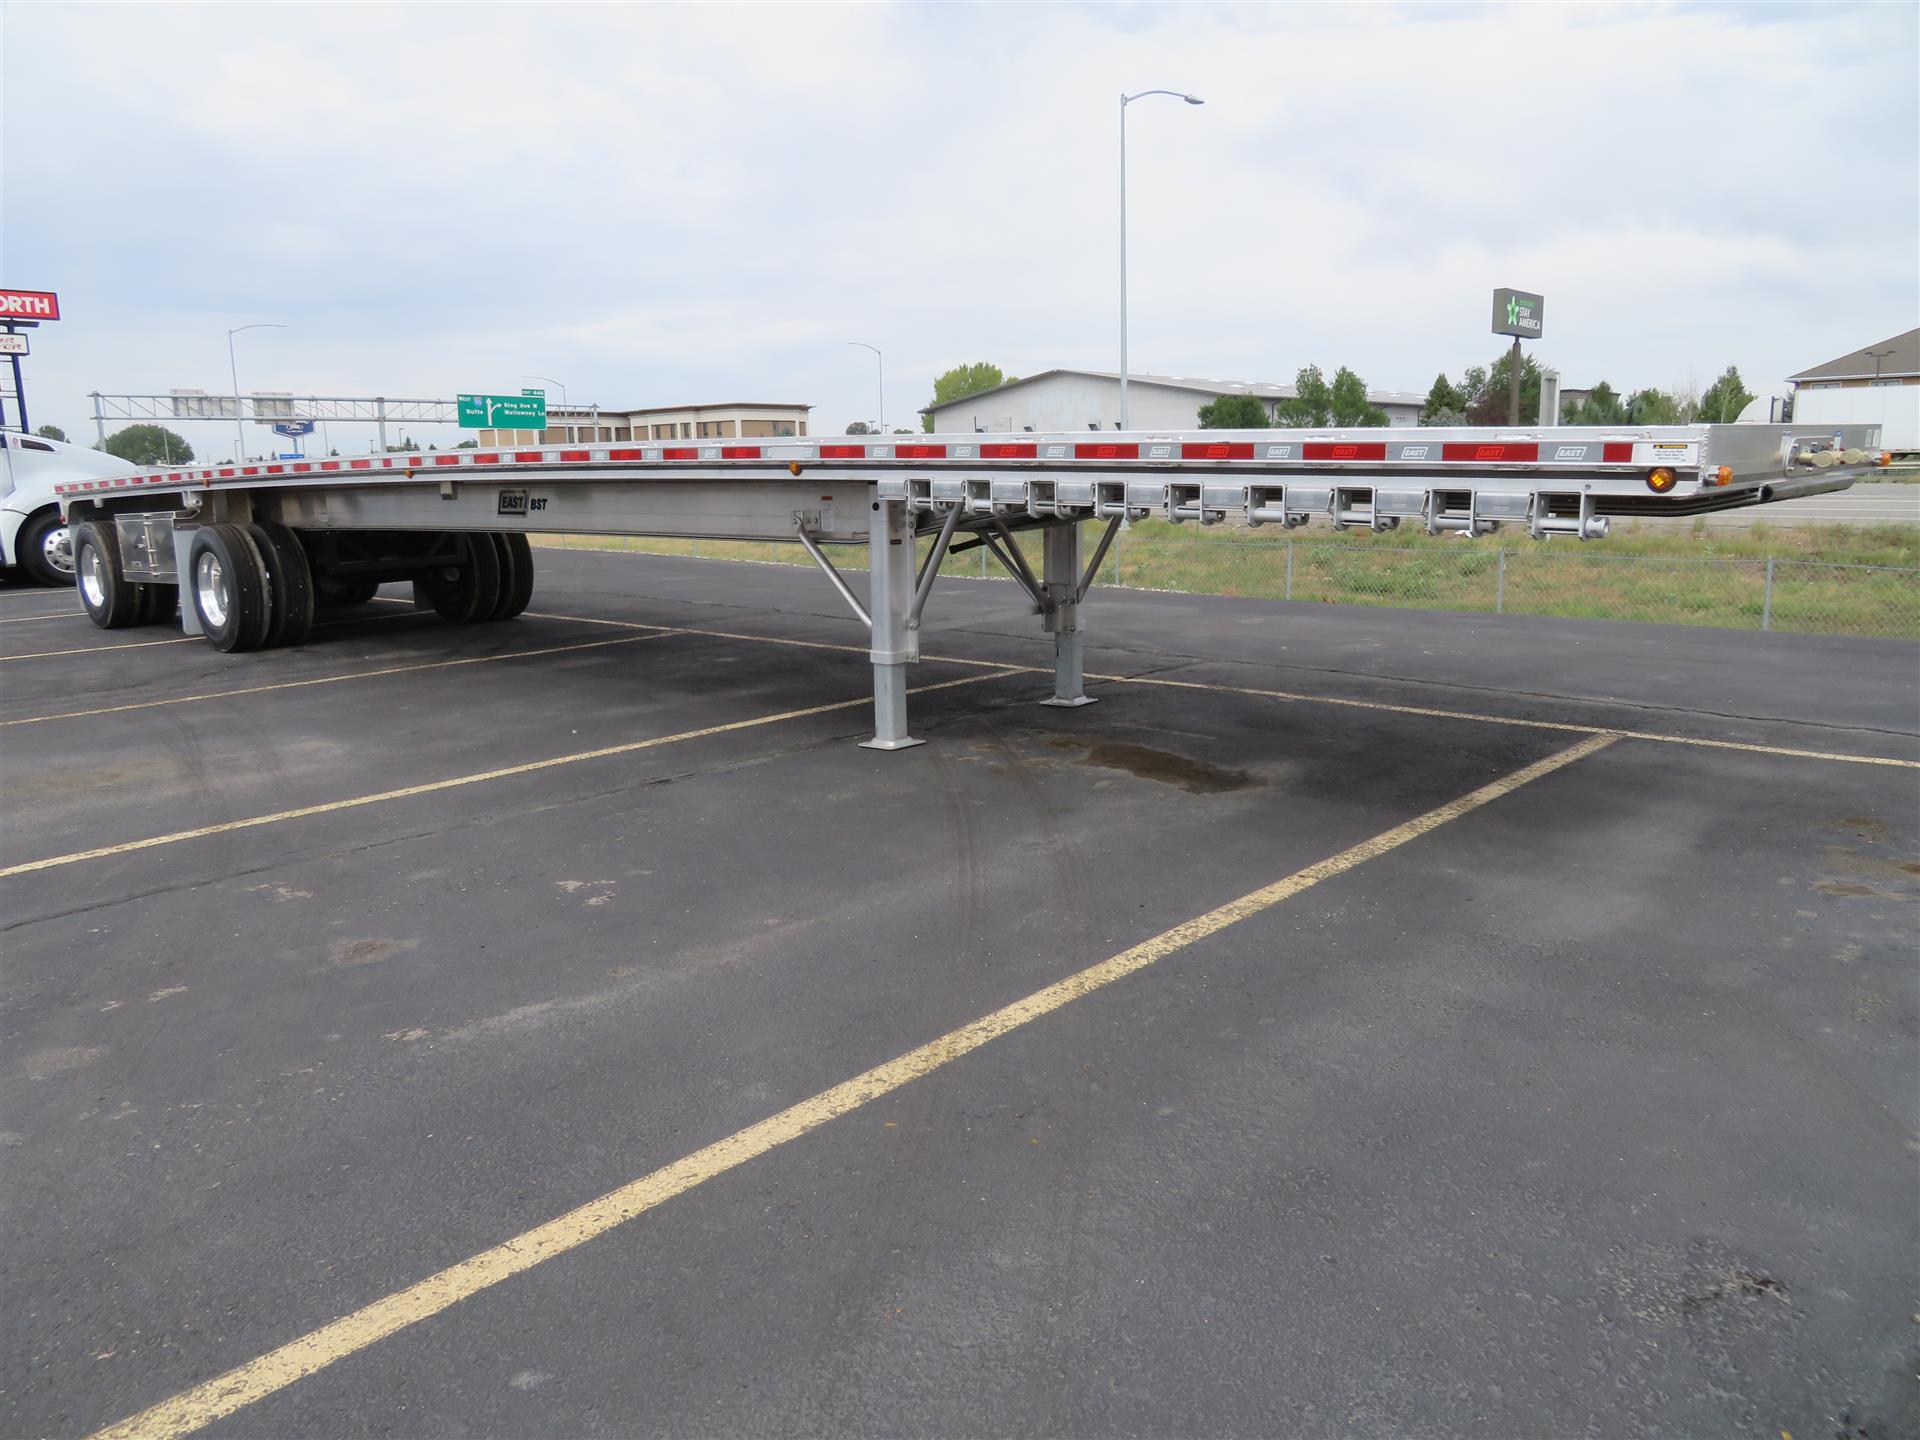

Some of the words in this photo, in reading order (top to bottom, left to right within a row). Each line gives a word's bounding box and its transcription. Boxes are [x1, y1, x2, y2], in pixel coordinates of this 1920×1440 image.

[1519, 307, 1531, 317] STAY
[1519, 318, 1540, 330] AMERICA
[502, 495, 523, 509] EAST
[530, 498, 548, 510] BST
